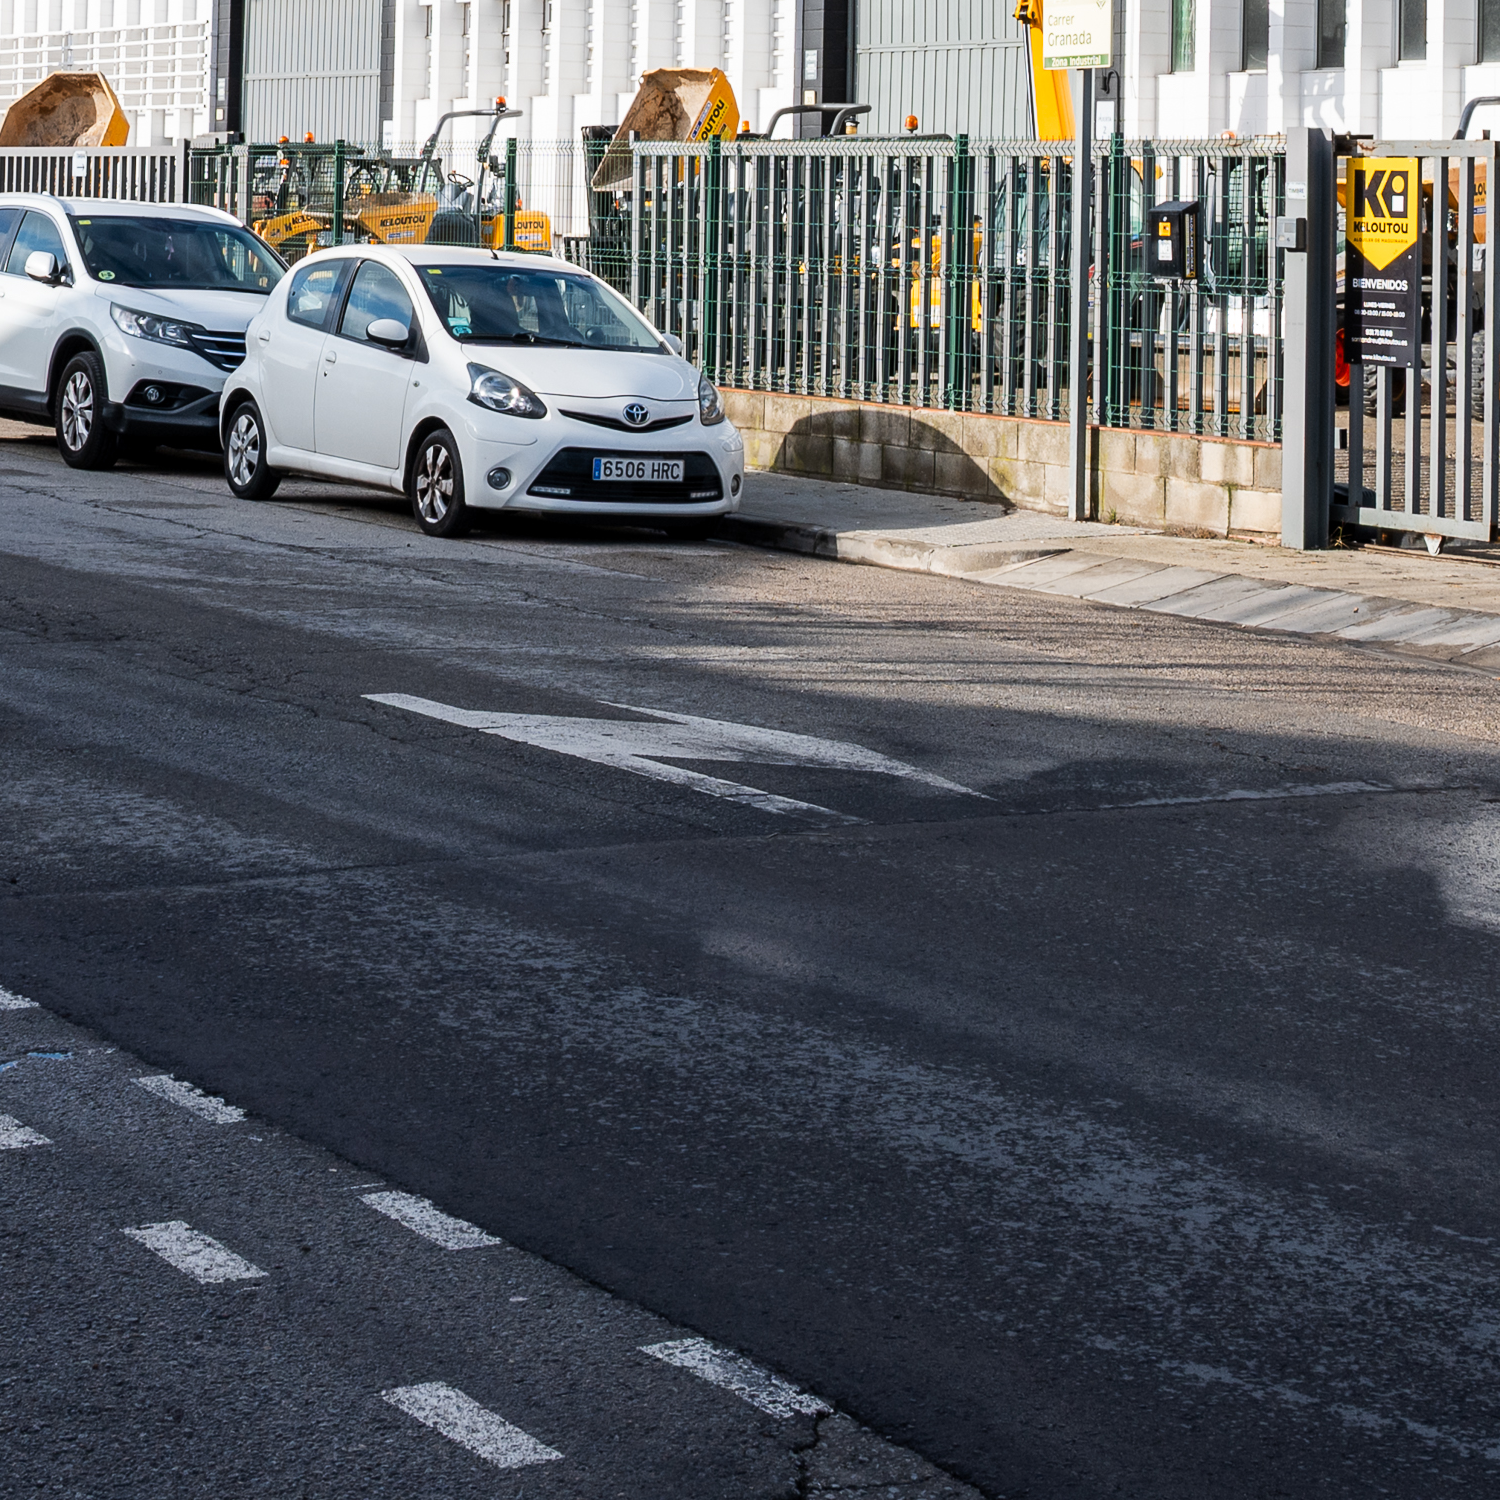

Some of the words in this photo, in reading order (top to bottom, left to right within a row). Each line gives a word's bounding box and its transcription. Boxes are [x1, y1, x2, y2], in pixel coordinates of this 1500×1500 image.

[1048, 14, 1075, 26] Carrer
[1048, 31, 1092, 47] Granada
[1051, 57, 1068, 67] Zona
[1069, 55, 1102, 66] Industrial
[1352, 278, 1408, 291] BIENVENIDOS
[603, 460, 645, 478] 6506
[651, 462, 680, 479] HRC
